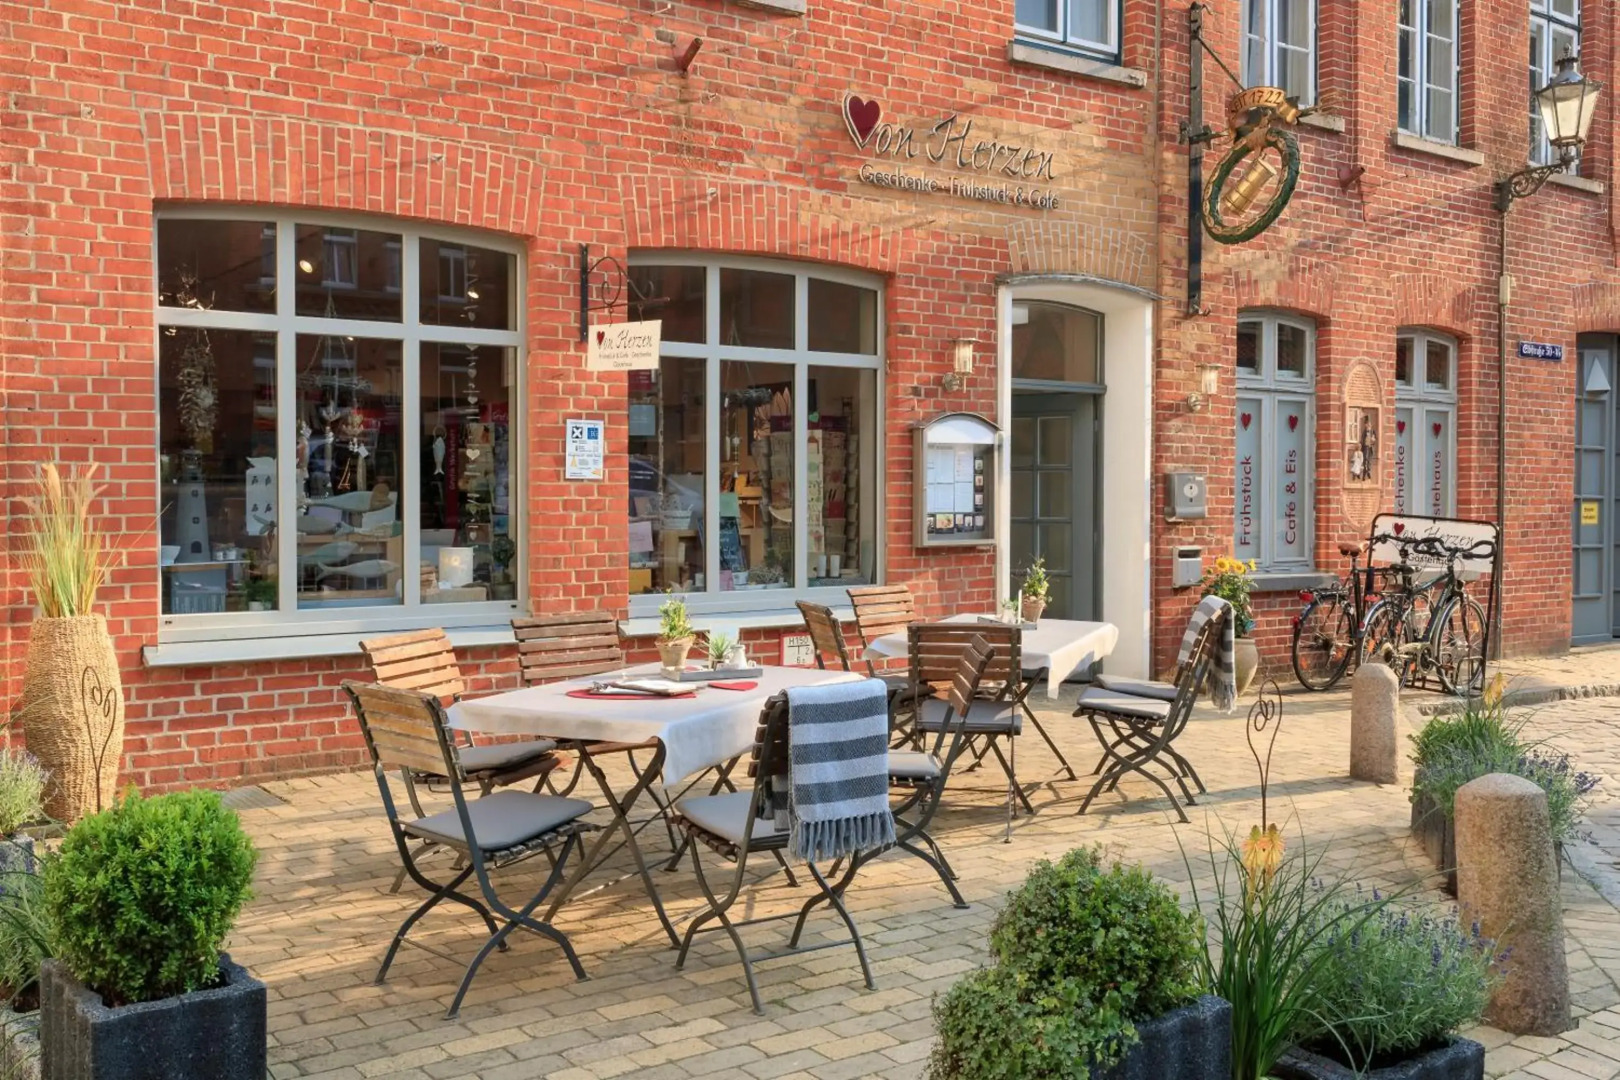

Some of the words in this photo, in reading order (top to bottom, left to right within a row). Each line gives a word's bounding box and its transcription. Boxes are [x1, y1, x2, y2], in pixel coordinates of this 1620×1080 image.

[1250, 89, 1283, 105] 1722
[926, 112, 1056, 181] Herzen
[858, 163, 938, 194] Geschenke
[1013, 186, 1023, 205] &
[1027, 188, 1060, 210] Café
[616, 329, 653, 349] Herzen
[1285, 449, 1297, 474] Eis
[1285, 482, 1297, 494] &
[1395, 445, 1405, 516] schenke
[1431, 450, 1442, 516] stehaus
[1239, 455, 1252, 546] Frühstück
[1285, 501, 1297, 545] Café
[1424, 526, 1474, 547] Hrzen
[1407, 552, 1449, 566] Gästehau
[788, 636, 809, 645] H150
